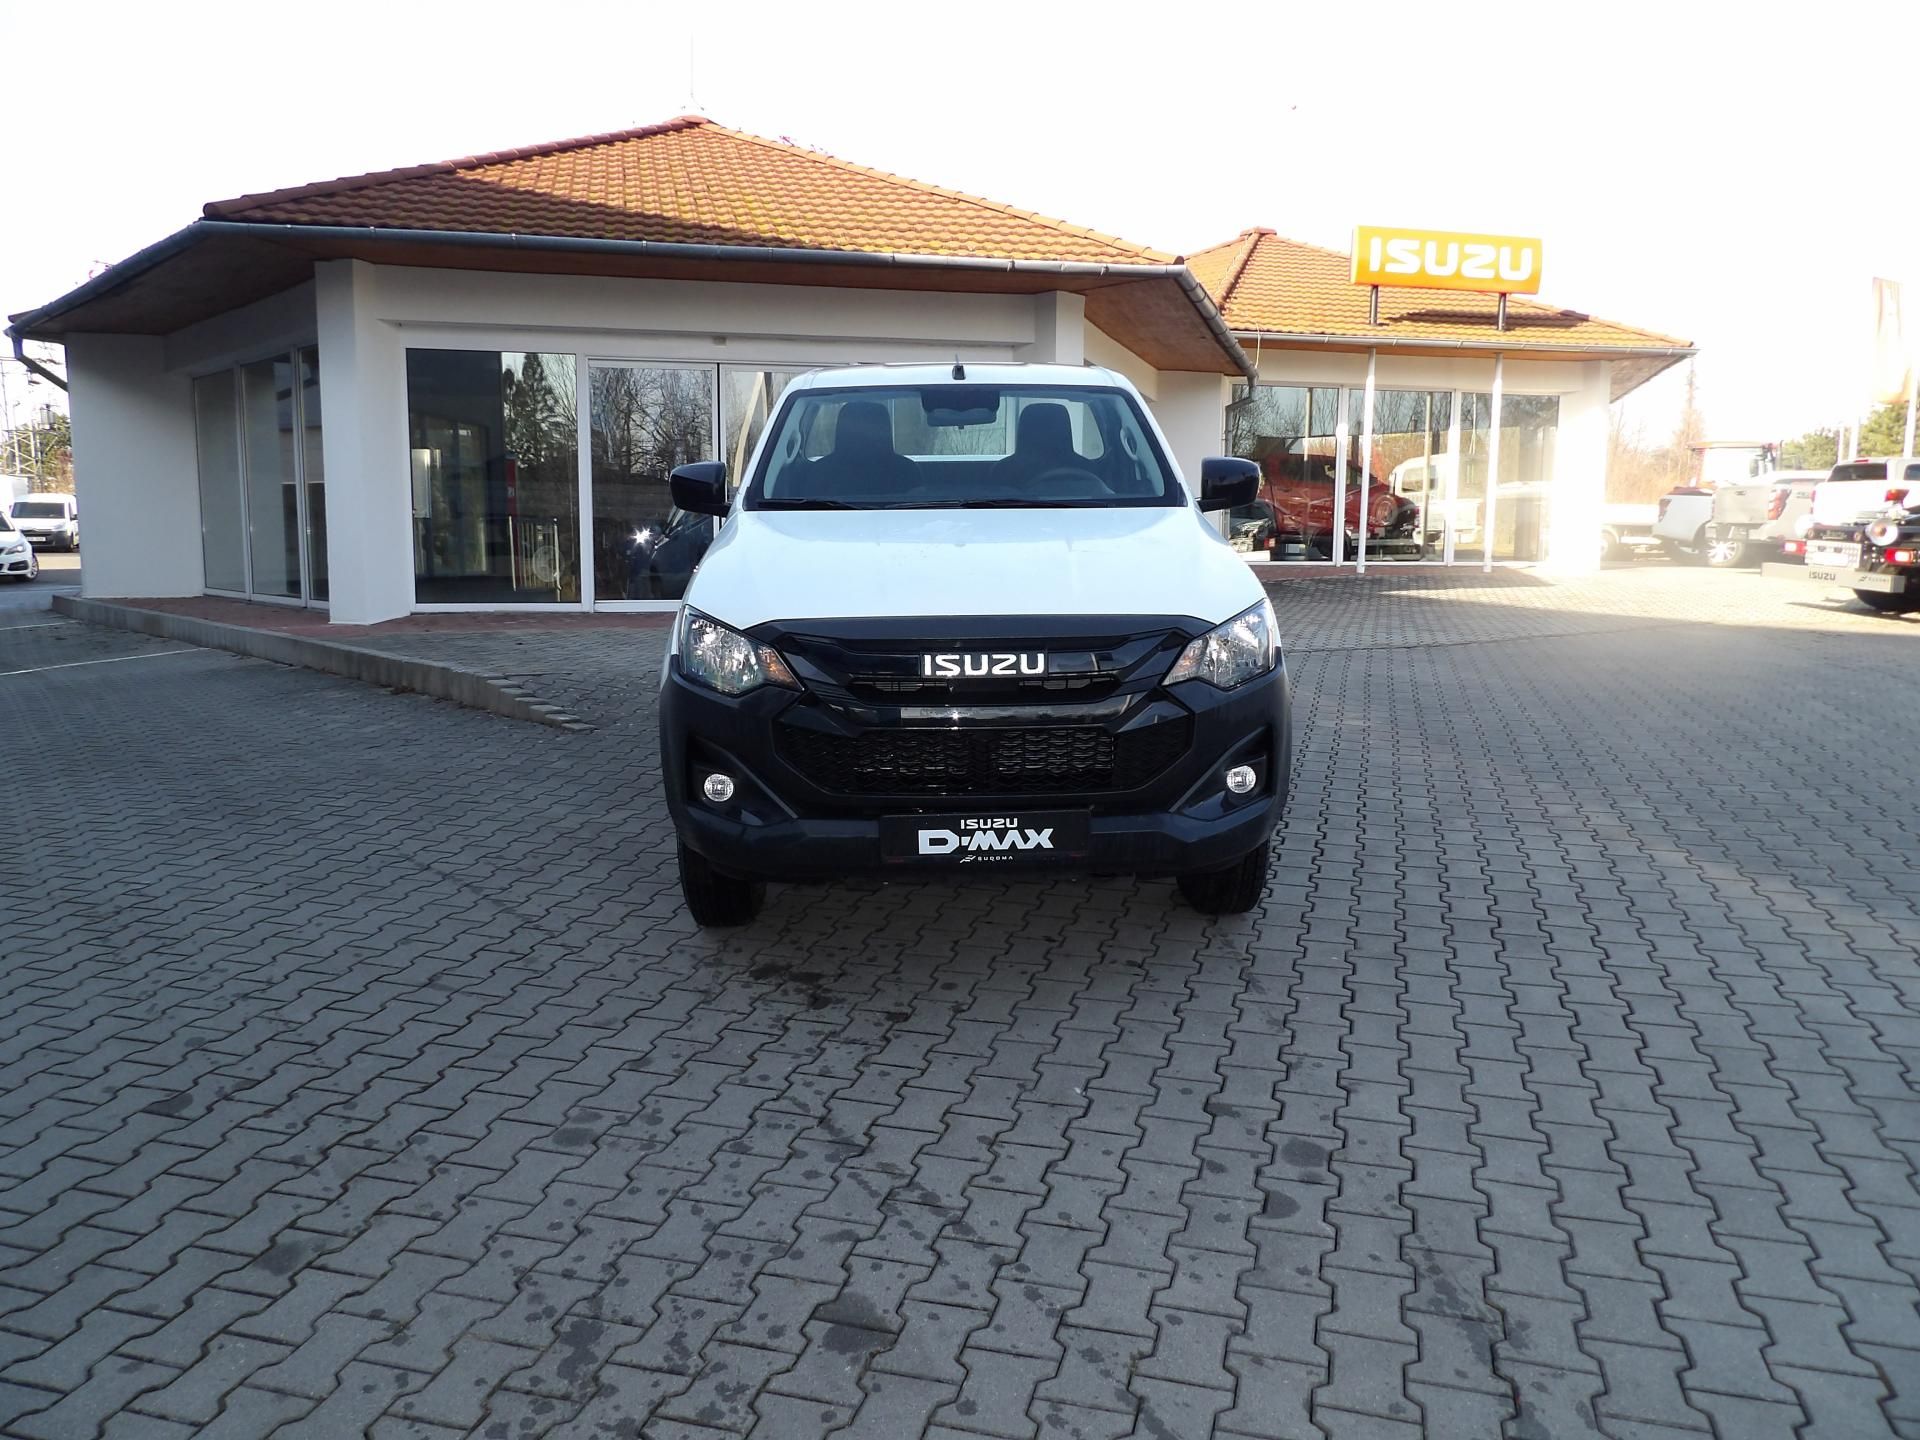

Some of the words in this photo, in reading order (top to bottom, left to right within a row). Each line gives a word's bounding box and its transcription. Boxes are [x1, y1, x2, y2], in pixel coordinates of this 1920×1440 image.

[1369, 236, 1533, 281] ISUZU
[1808, 570, 1836, 581] ISUZU
[924, 653, 1045, 676] ISUZU
[960, 818, 1018, 829] ISUZU
[918, 828, 1054, 854] D-MAX
